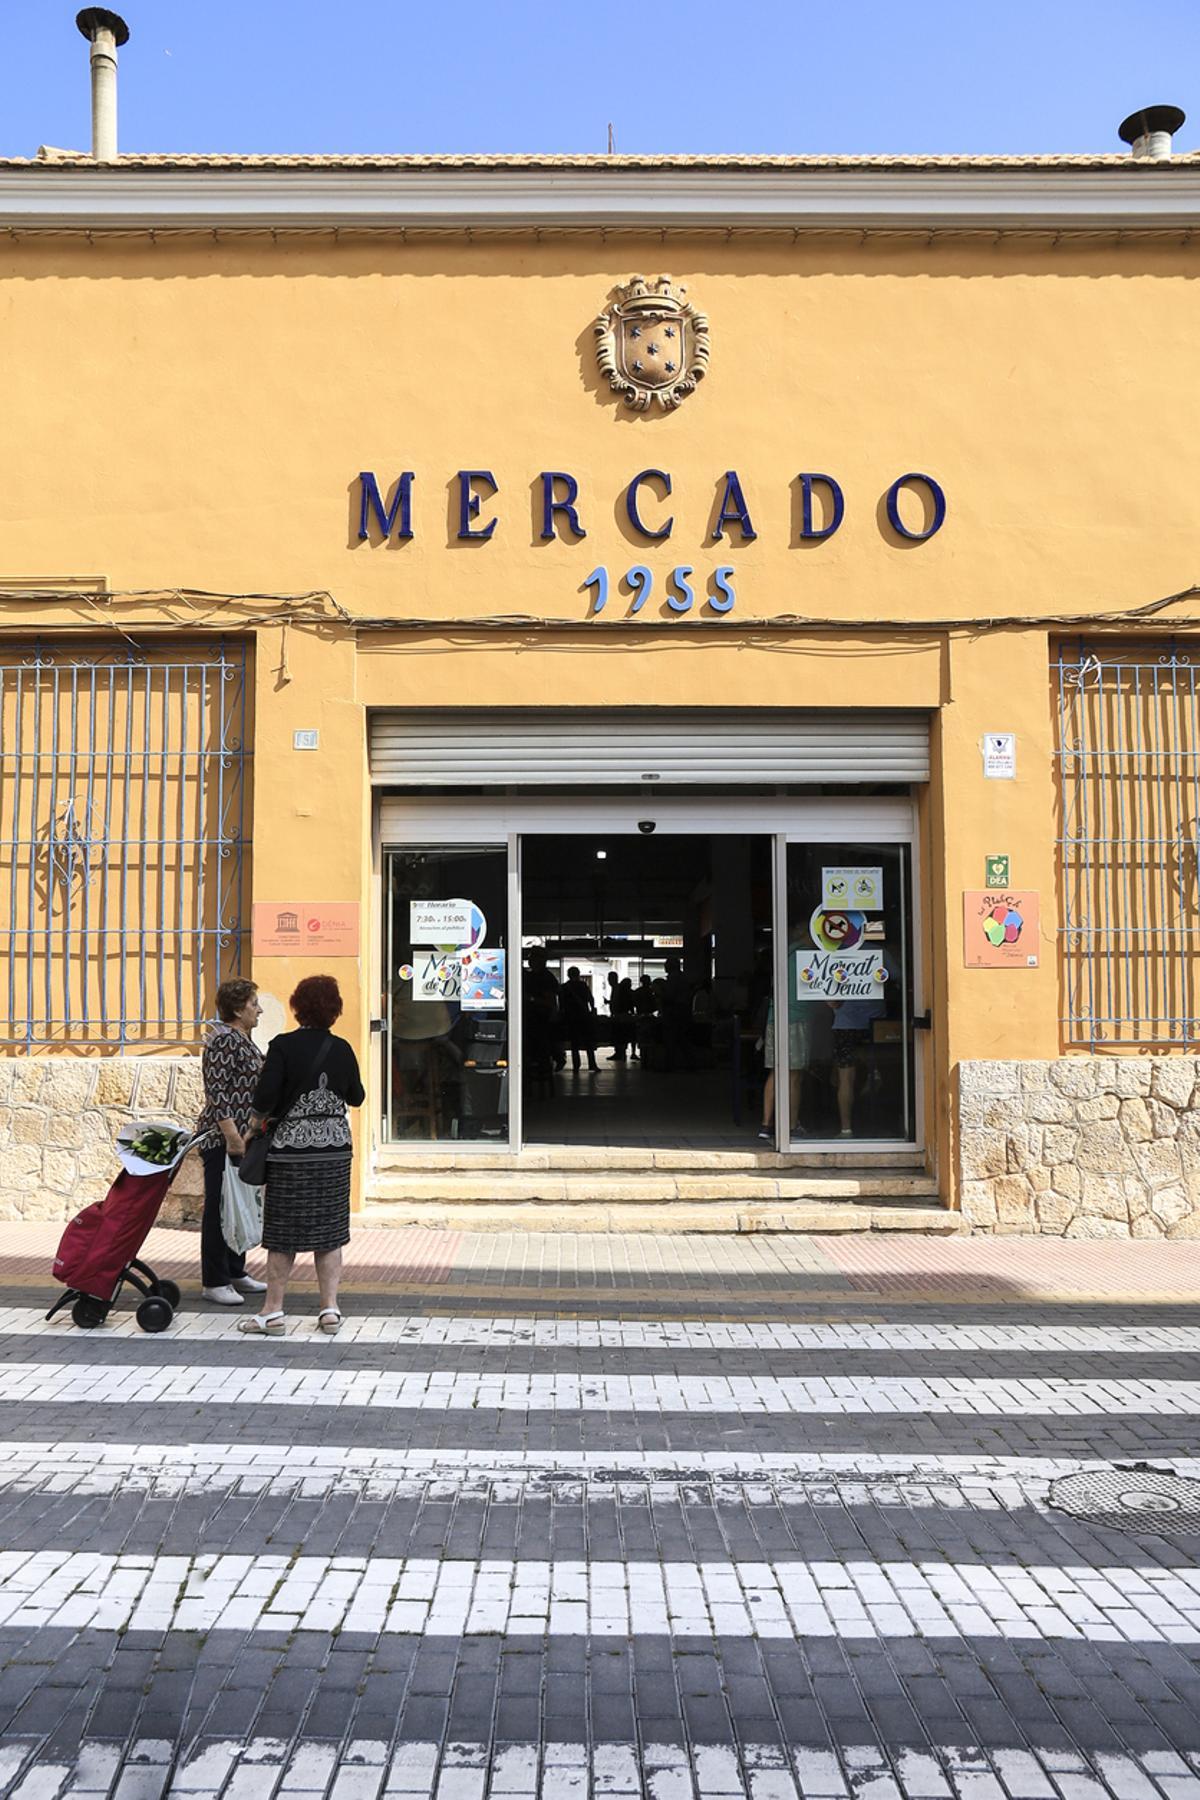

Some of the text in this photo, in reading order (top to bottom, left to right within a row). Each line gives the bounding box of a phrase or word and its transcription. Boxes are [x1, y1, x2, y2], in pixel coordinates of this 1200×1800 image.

[359, 468, 947, 540] MERCADO
[584, 565, 736, 614] 1955
[990, 876, 1007, 885] DEA
[809, 952, 879, 980] Mercat
[425, 977, 439, 990] de
[809, 977, 823, 989] de
